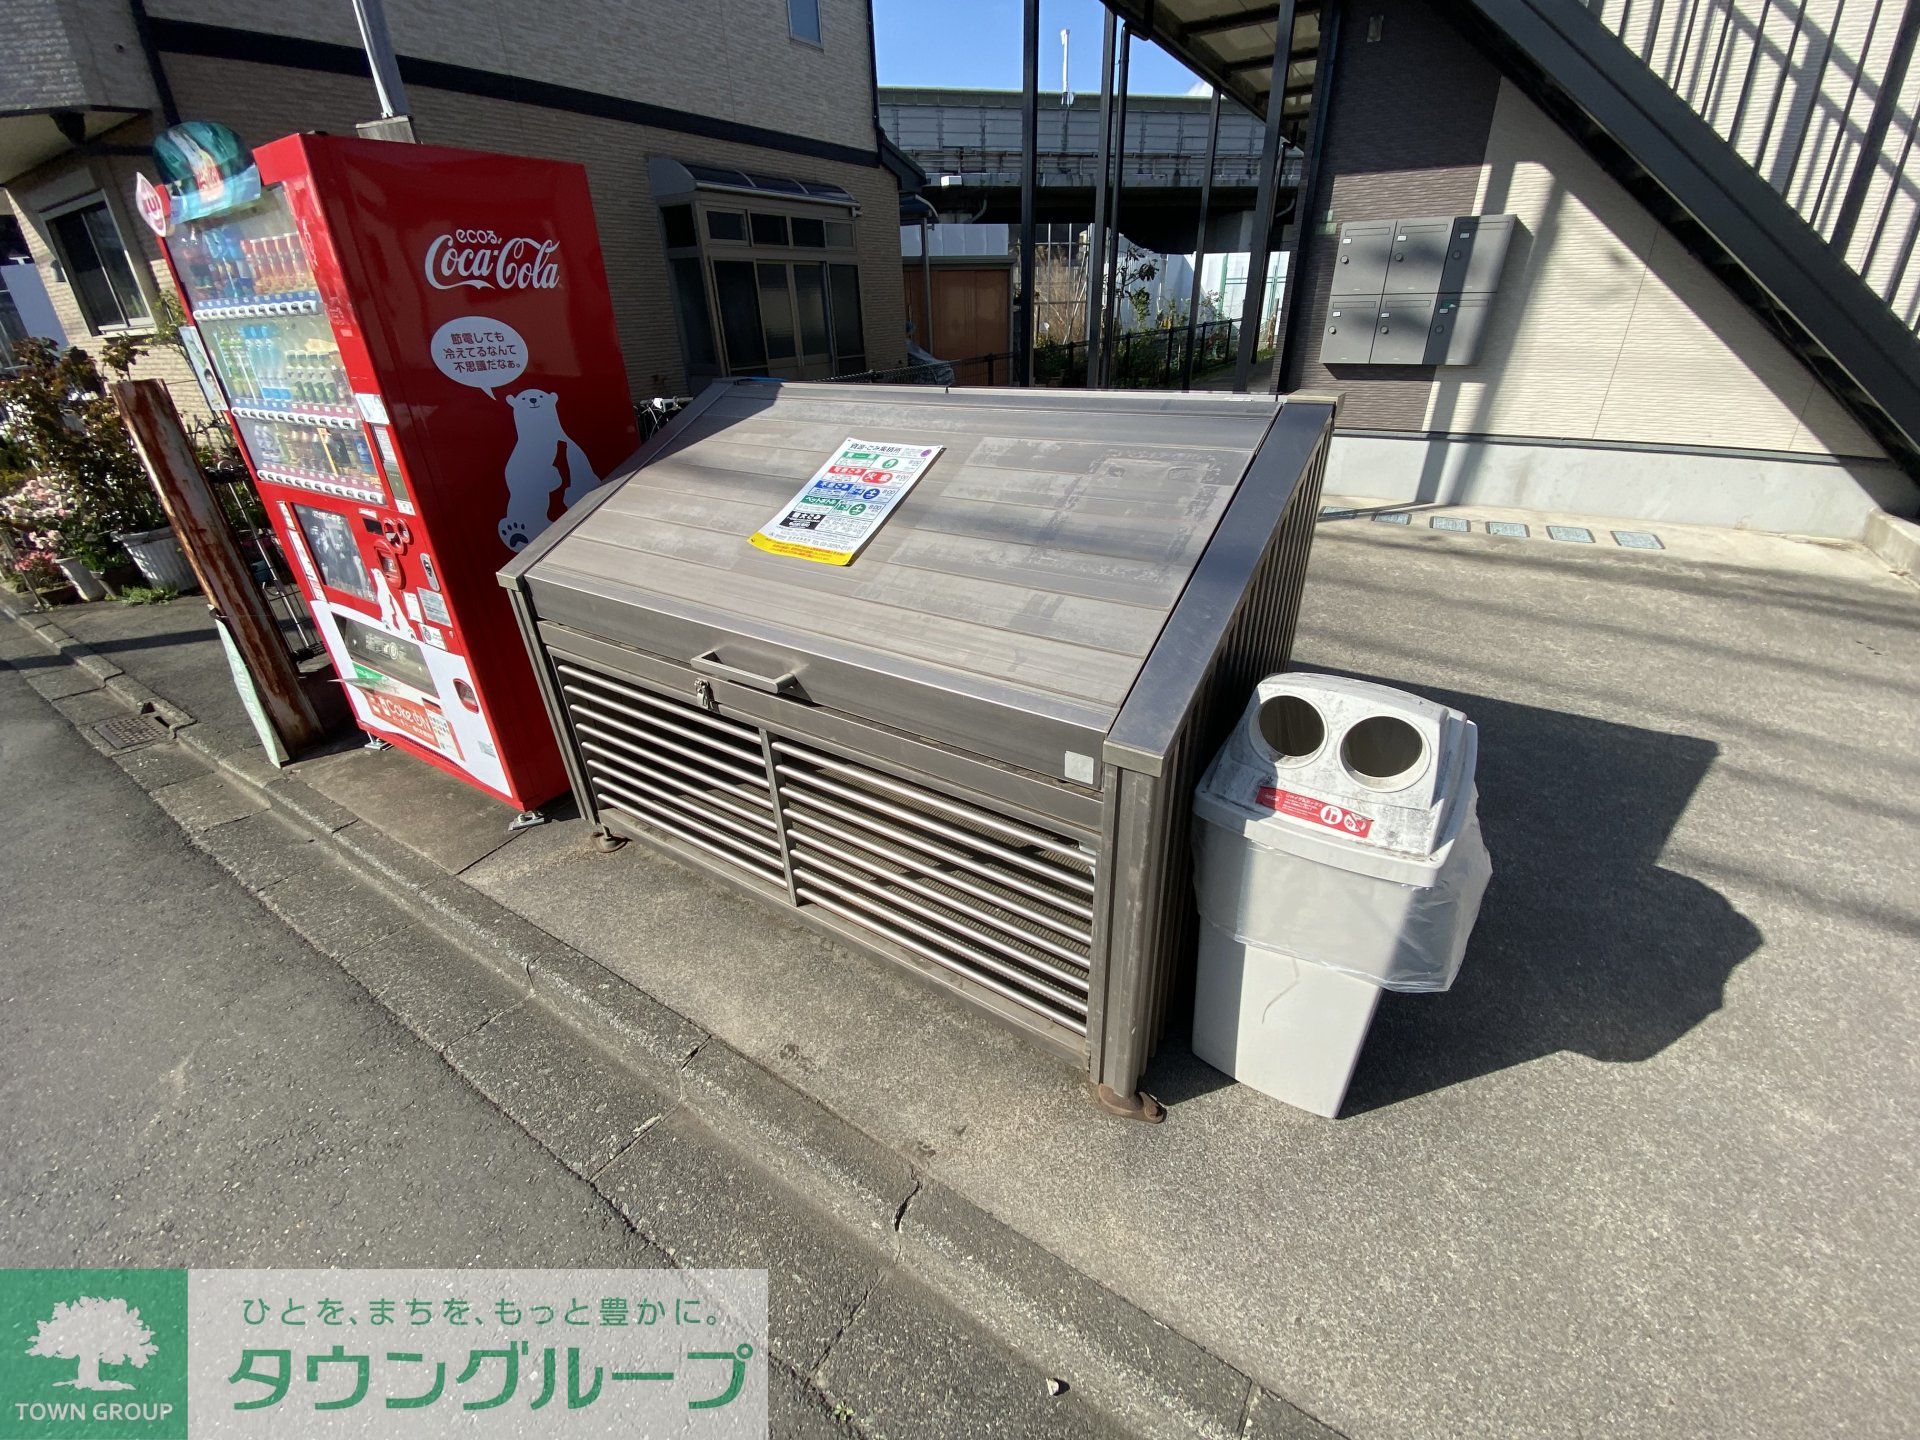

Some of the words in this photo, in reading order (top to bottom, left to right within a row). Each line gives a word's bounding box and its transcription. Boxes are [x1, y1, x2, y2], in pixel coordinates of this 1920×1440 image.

[425, 234, 560, 290] Coca-Cola
[450, 332, 505, 346] 節電しても
[443, 344, 517, 360] 冷えてるなんて
